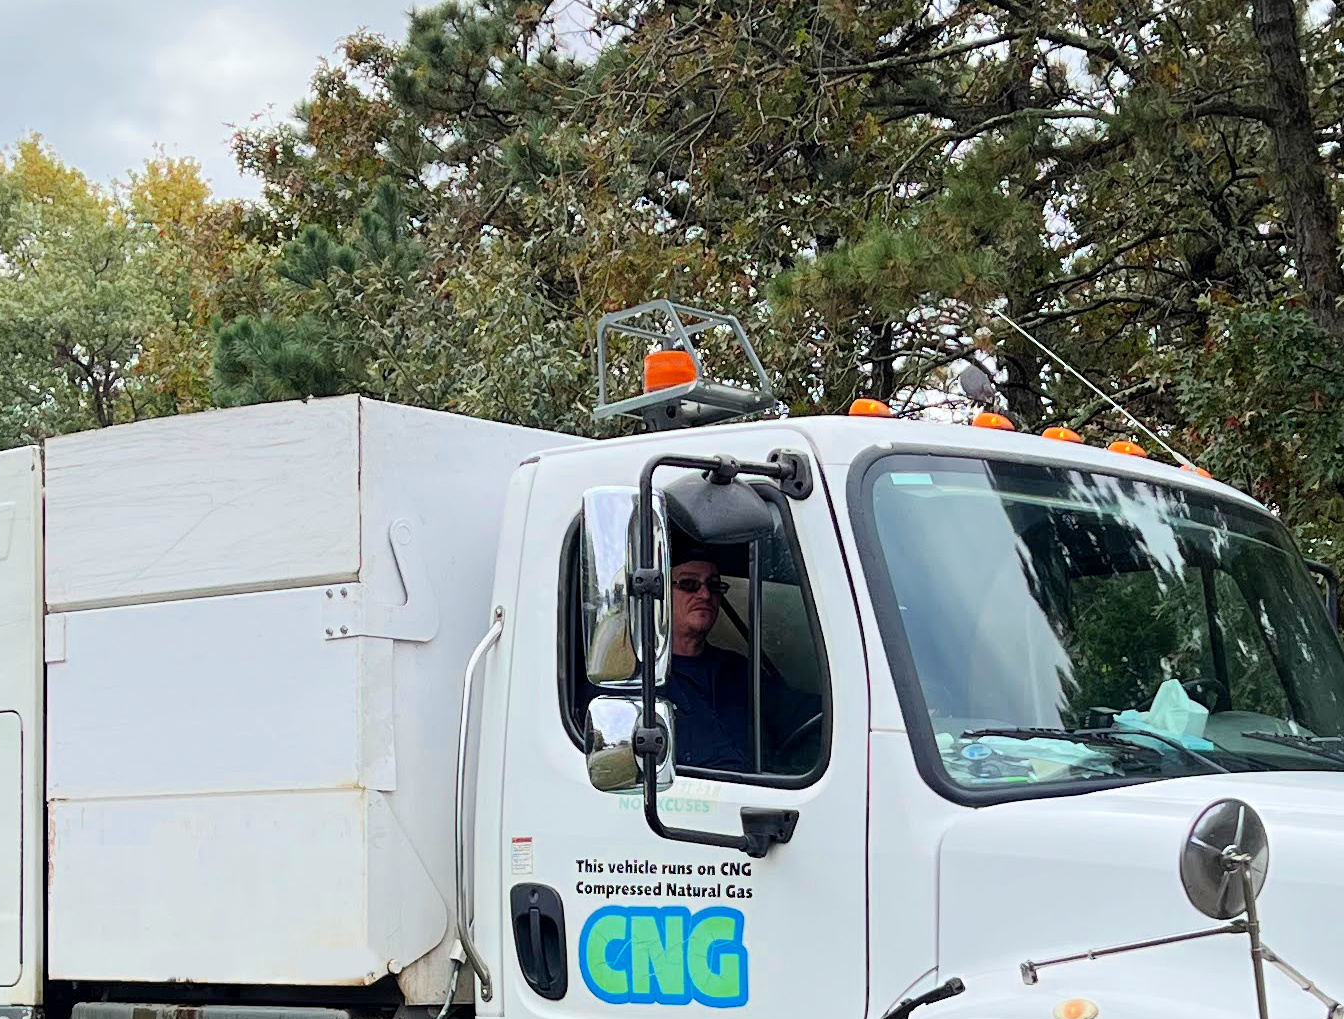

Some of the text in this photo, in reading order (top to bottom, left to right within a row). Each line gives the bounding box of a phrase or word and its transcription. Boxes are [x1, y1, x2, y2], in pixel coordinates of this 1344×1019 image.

[618, 797, 712, 813] NO XCUSES
[576, 859, 752, 876] This vehicle runs on CNG
[575, 881, 753, 899] Compressed Natural Gas
[579, 906, 748, 1008] CNG
